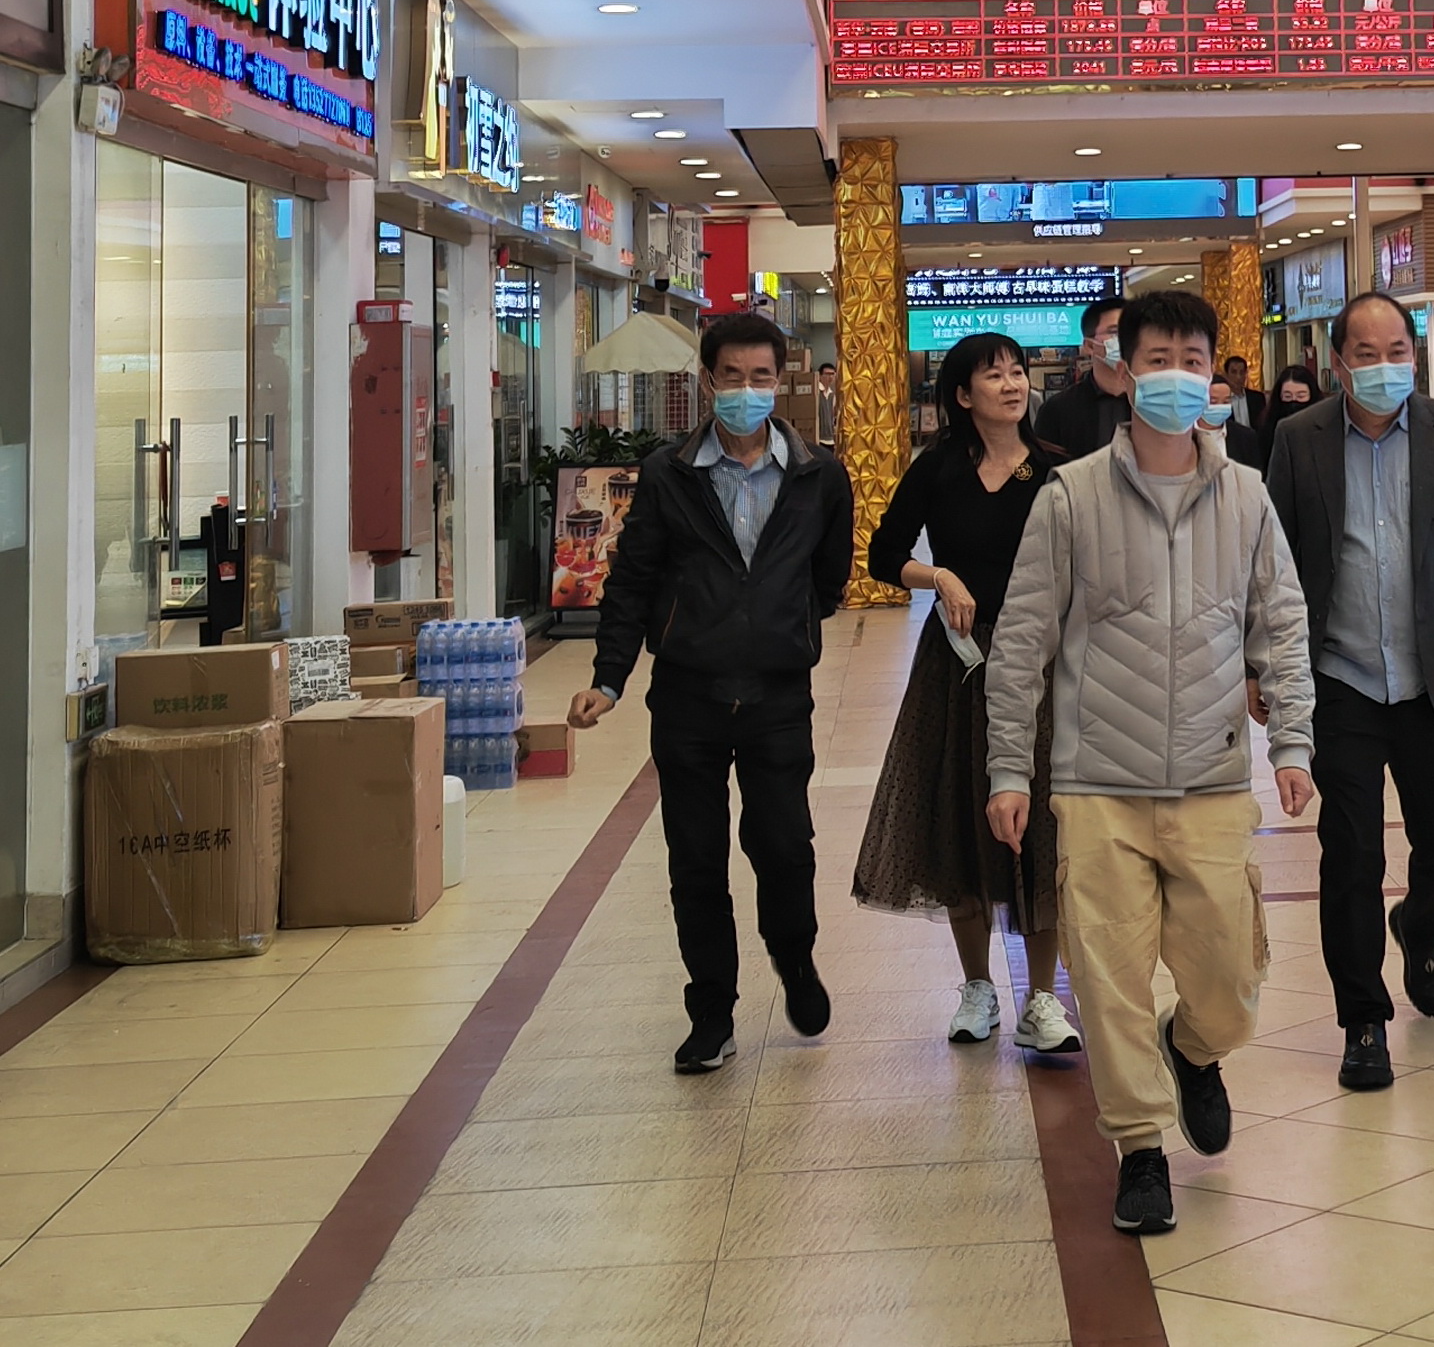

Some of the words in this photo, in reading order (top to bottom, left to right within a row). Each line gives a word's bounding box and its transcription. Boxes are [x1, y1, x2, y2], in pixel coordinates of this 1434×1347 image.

[932, 314, 973, 327] WAN
[976, 313, 998, 325] YU
[1003, 312, 1042, 325] SHUI
[1046, 311, 1069, 324] BA
[153, 693, 228, 715] 饮料浓浆
